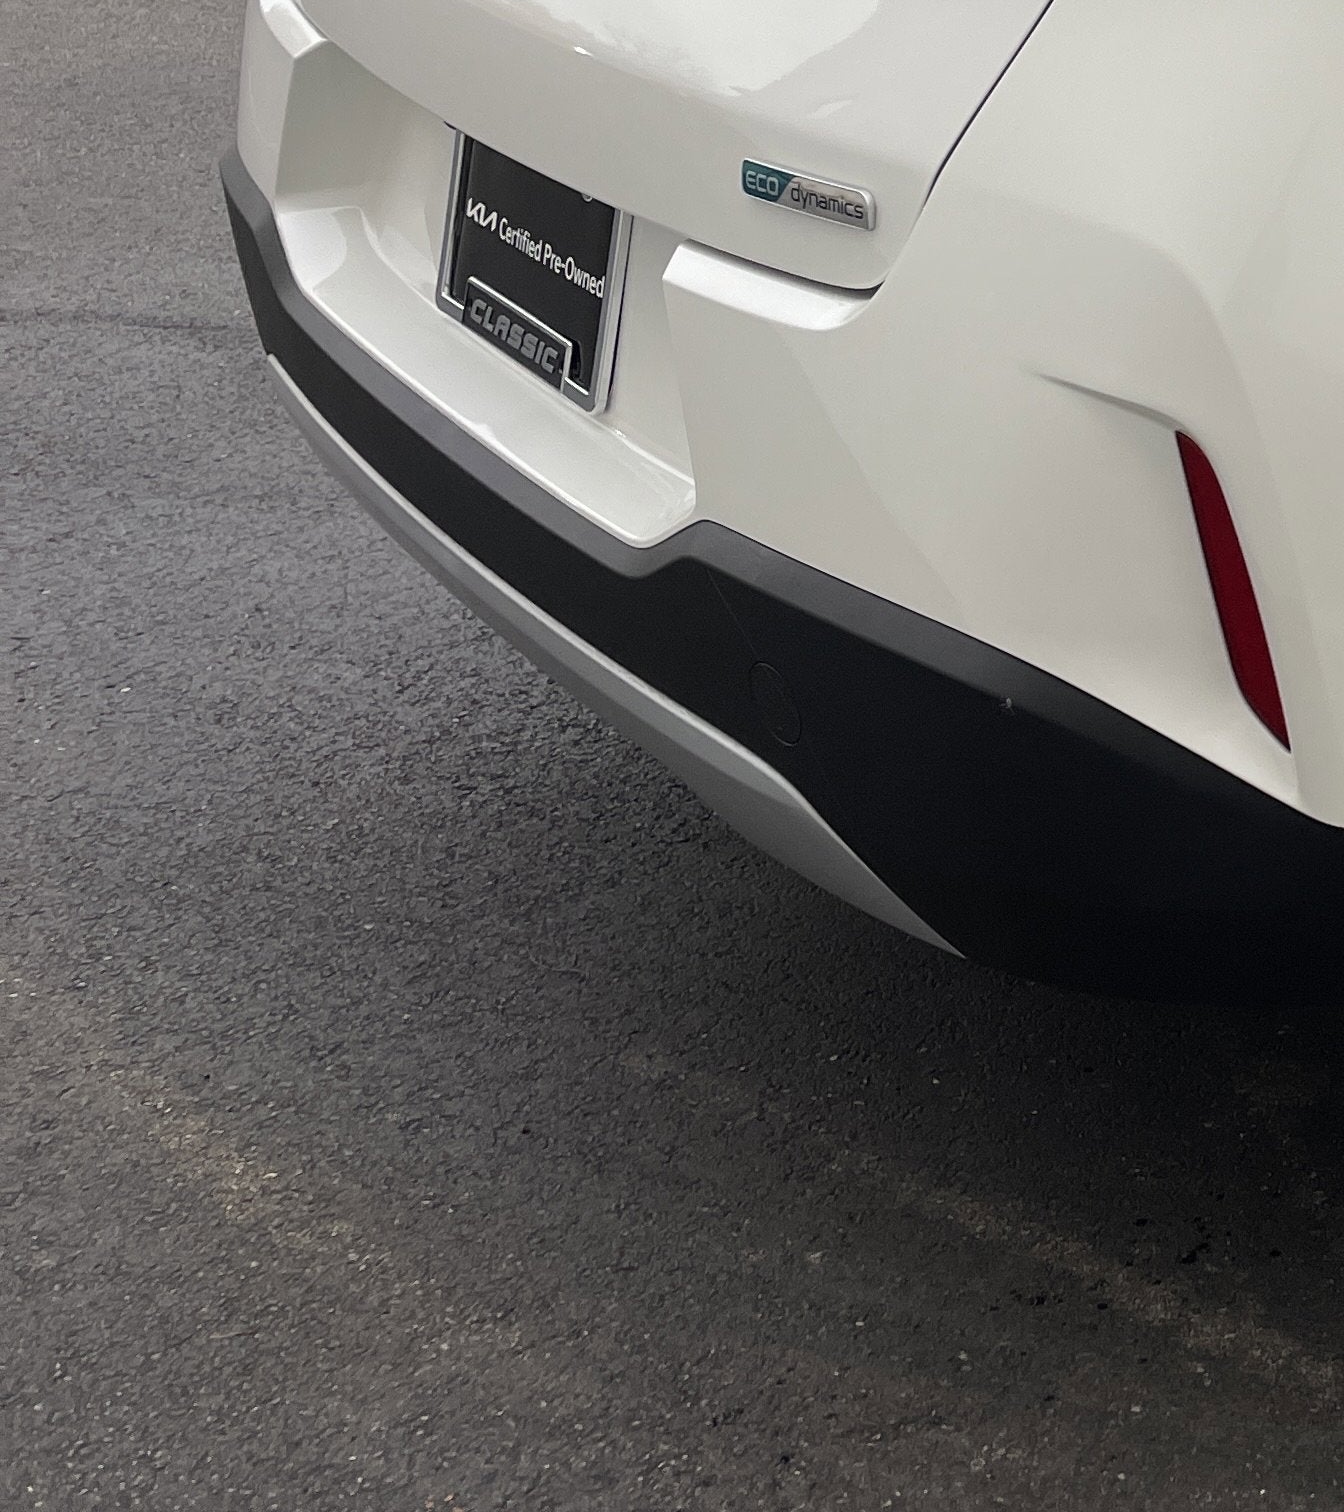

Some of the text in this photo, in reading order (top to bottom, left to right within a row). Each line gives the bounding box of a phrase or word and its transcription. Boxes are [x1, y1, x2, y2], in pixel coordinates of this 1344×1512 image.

[745, 170, 864, 219] ECO dynamics
[466, 197, 606, 299] KIA Certified Pre-Owned
[470, 298, 559, 374] CLASSIC
